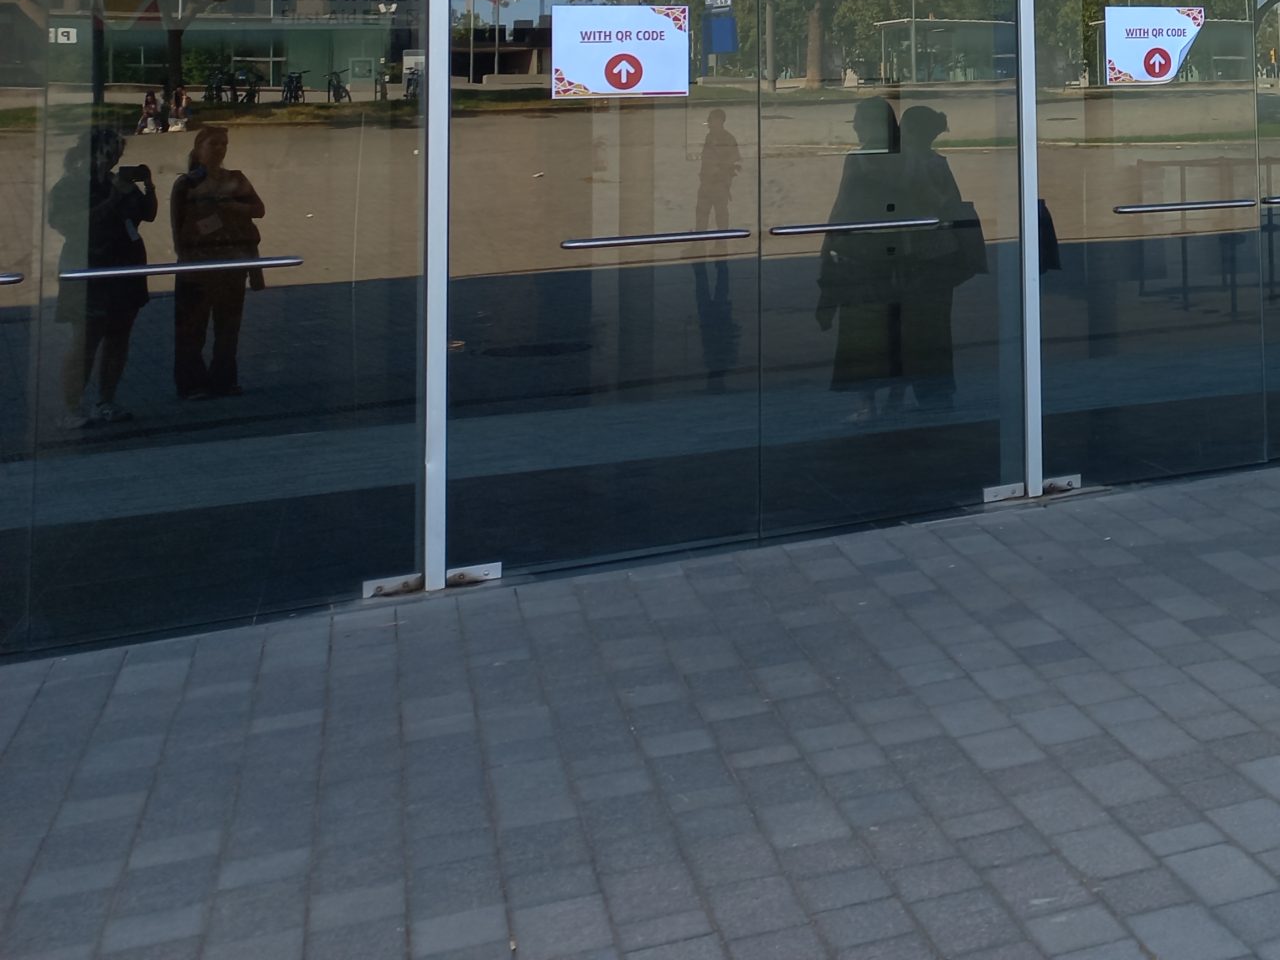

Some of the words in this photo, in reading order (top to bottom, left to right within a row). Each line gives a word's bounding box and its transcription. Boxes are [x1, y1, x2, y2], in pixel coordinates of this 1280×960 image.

[580, 30, 612, 42] WITH
[615, 30, 632, 42] QR
[636, 30, 665, 41] CODE
[1125, 28, 1149, 38] WITH
[1151, 28, 1164, 38] QR
[1166, 28, 1187, 37] CODE
